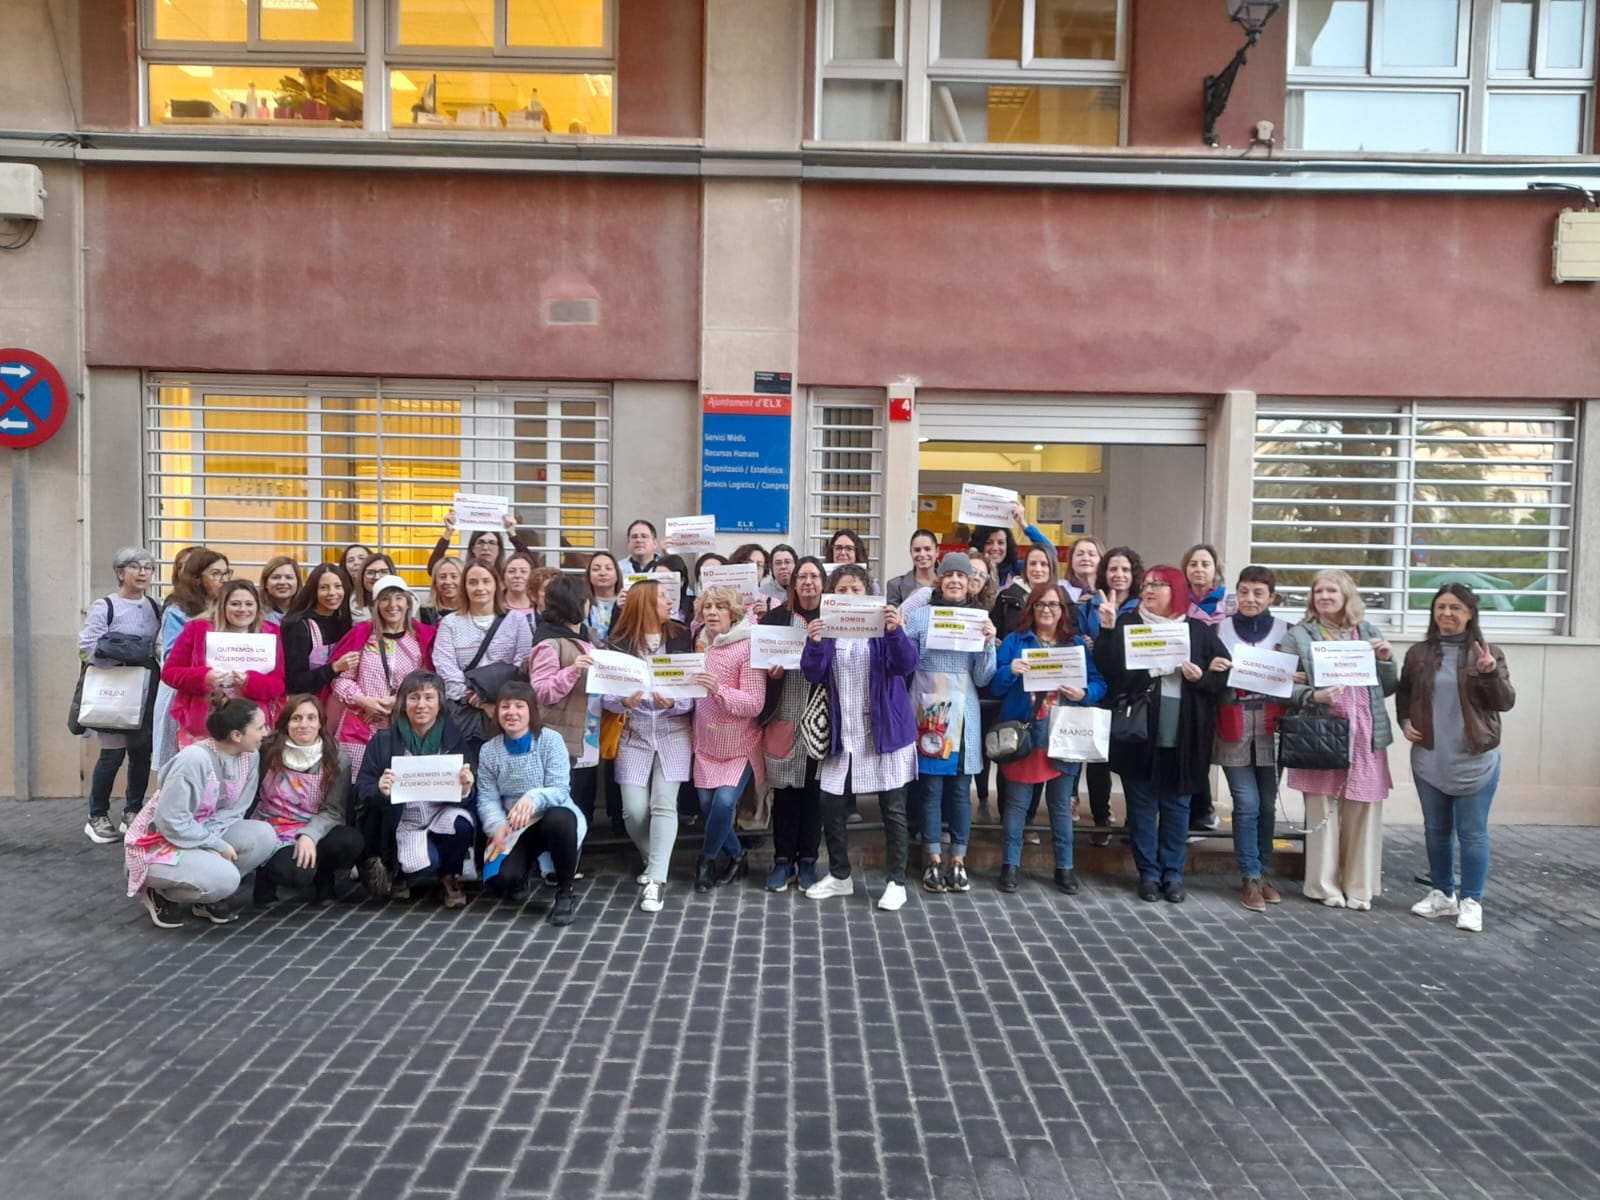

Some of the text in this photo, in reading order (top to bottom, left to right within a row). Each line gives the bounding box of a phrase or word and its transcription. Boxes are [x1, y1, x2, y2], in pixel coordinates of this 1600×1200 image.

[707, 397, 753, 408] Ajuntament
[901, 399, 910, 411] 4
[704, 449, 760, 458] Recursos Humans
[1060, 728, 1094, 737] MANGO
